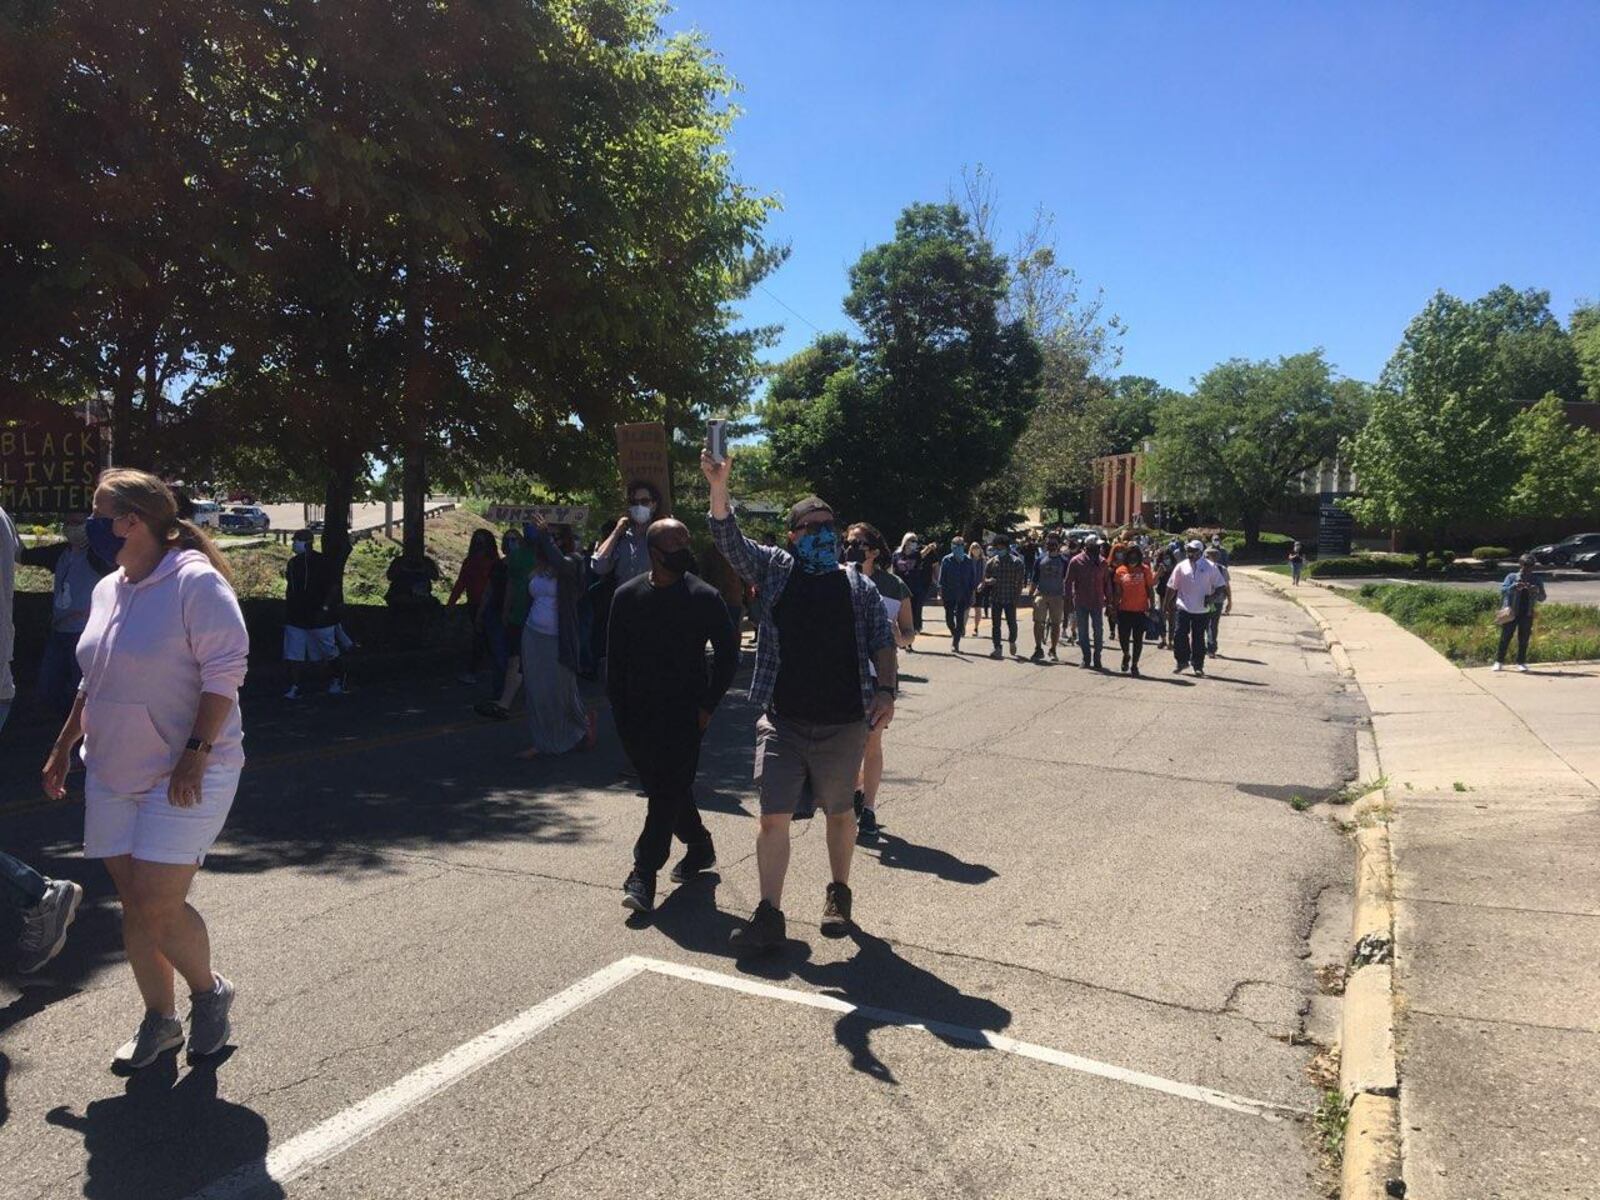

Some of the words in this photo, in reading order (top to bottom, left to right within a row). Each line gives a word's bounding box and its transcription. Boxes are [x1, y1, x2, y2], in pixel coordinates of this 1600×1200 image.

[1, 432, 96, 457] BLACK
[3, 460, 95, 484] LIVES
[0, 485, 93, 509] MATTER
